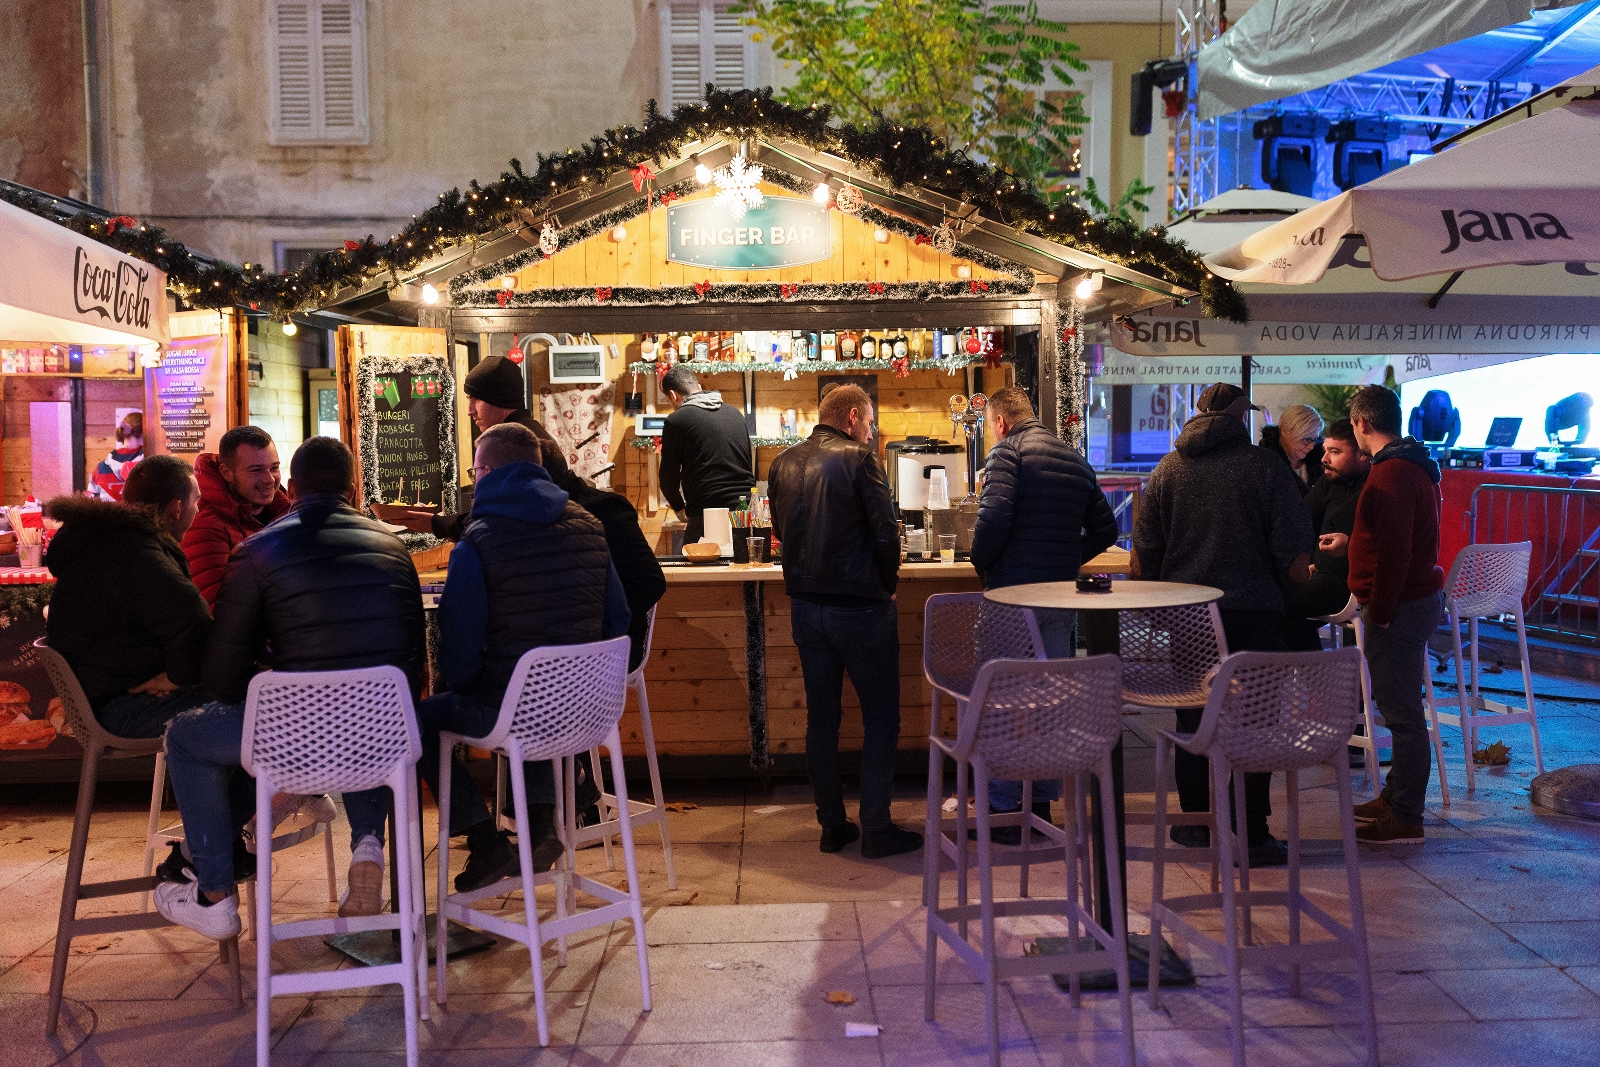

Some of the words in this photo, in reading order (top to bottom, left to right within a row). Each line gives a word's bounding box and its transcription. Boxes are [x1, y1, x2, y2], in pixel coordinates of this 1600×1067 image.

[680, 227, 764, 246] FINGER
[770, 226, 816, 245] BAR
[1440, 209, 1574, 254] Jana
[73, 245, 152, 330] Coca-Cola
[377, 410, 410, 420] BURGERI
[378, 424, 415, 434] KOBASICE
[379, 437, 424, 449] PANACOTTA
[378, 453, 403, 464] ONION
[406, 451, 429, 461] RINGS
[379, 467, 408, 479] POHANA
[410, 479, 430, 491] FRES
